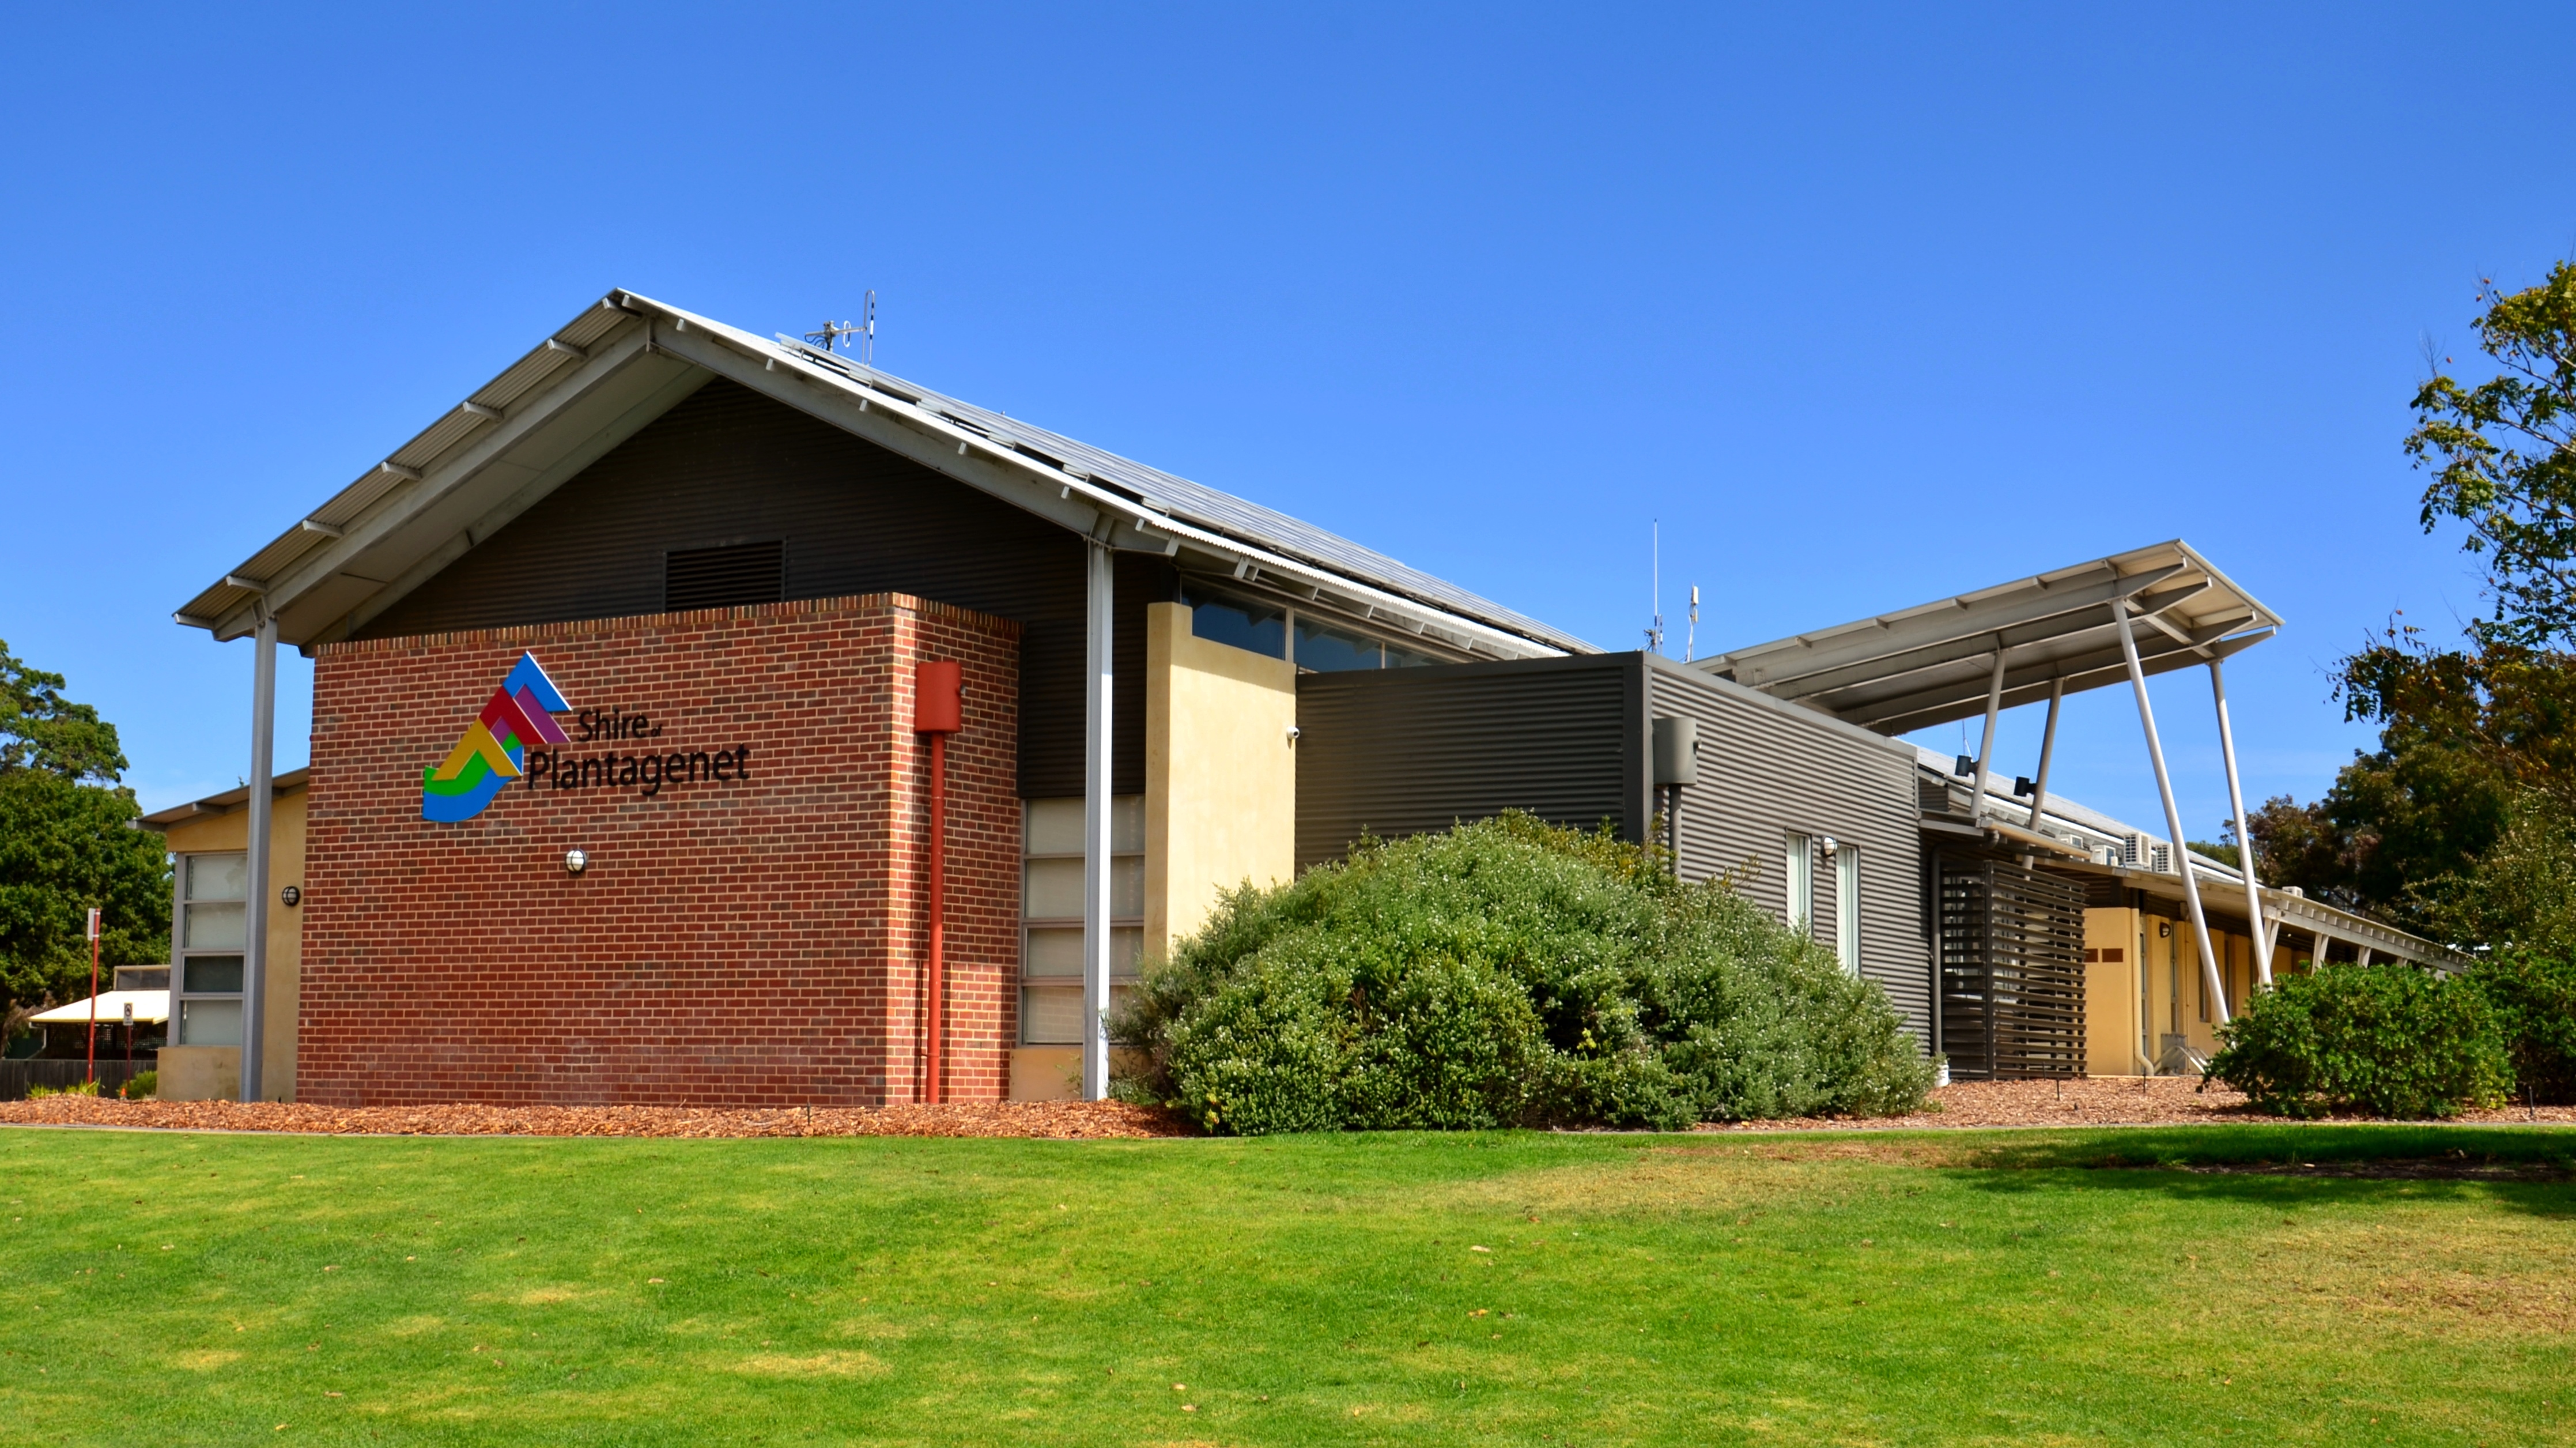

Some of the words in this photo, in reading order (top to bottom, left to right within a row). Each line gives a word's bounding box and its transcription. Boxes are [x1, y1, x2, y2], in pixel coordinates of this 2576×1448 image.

[578, 708, 648, 742] Shire
[651, 723, 663, 737] of
[528, 742, 749, 797] Plantagenet
